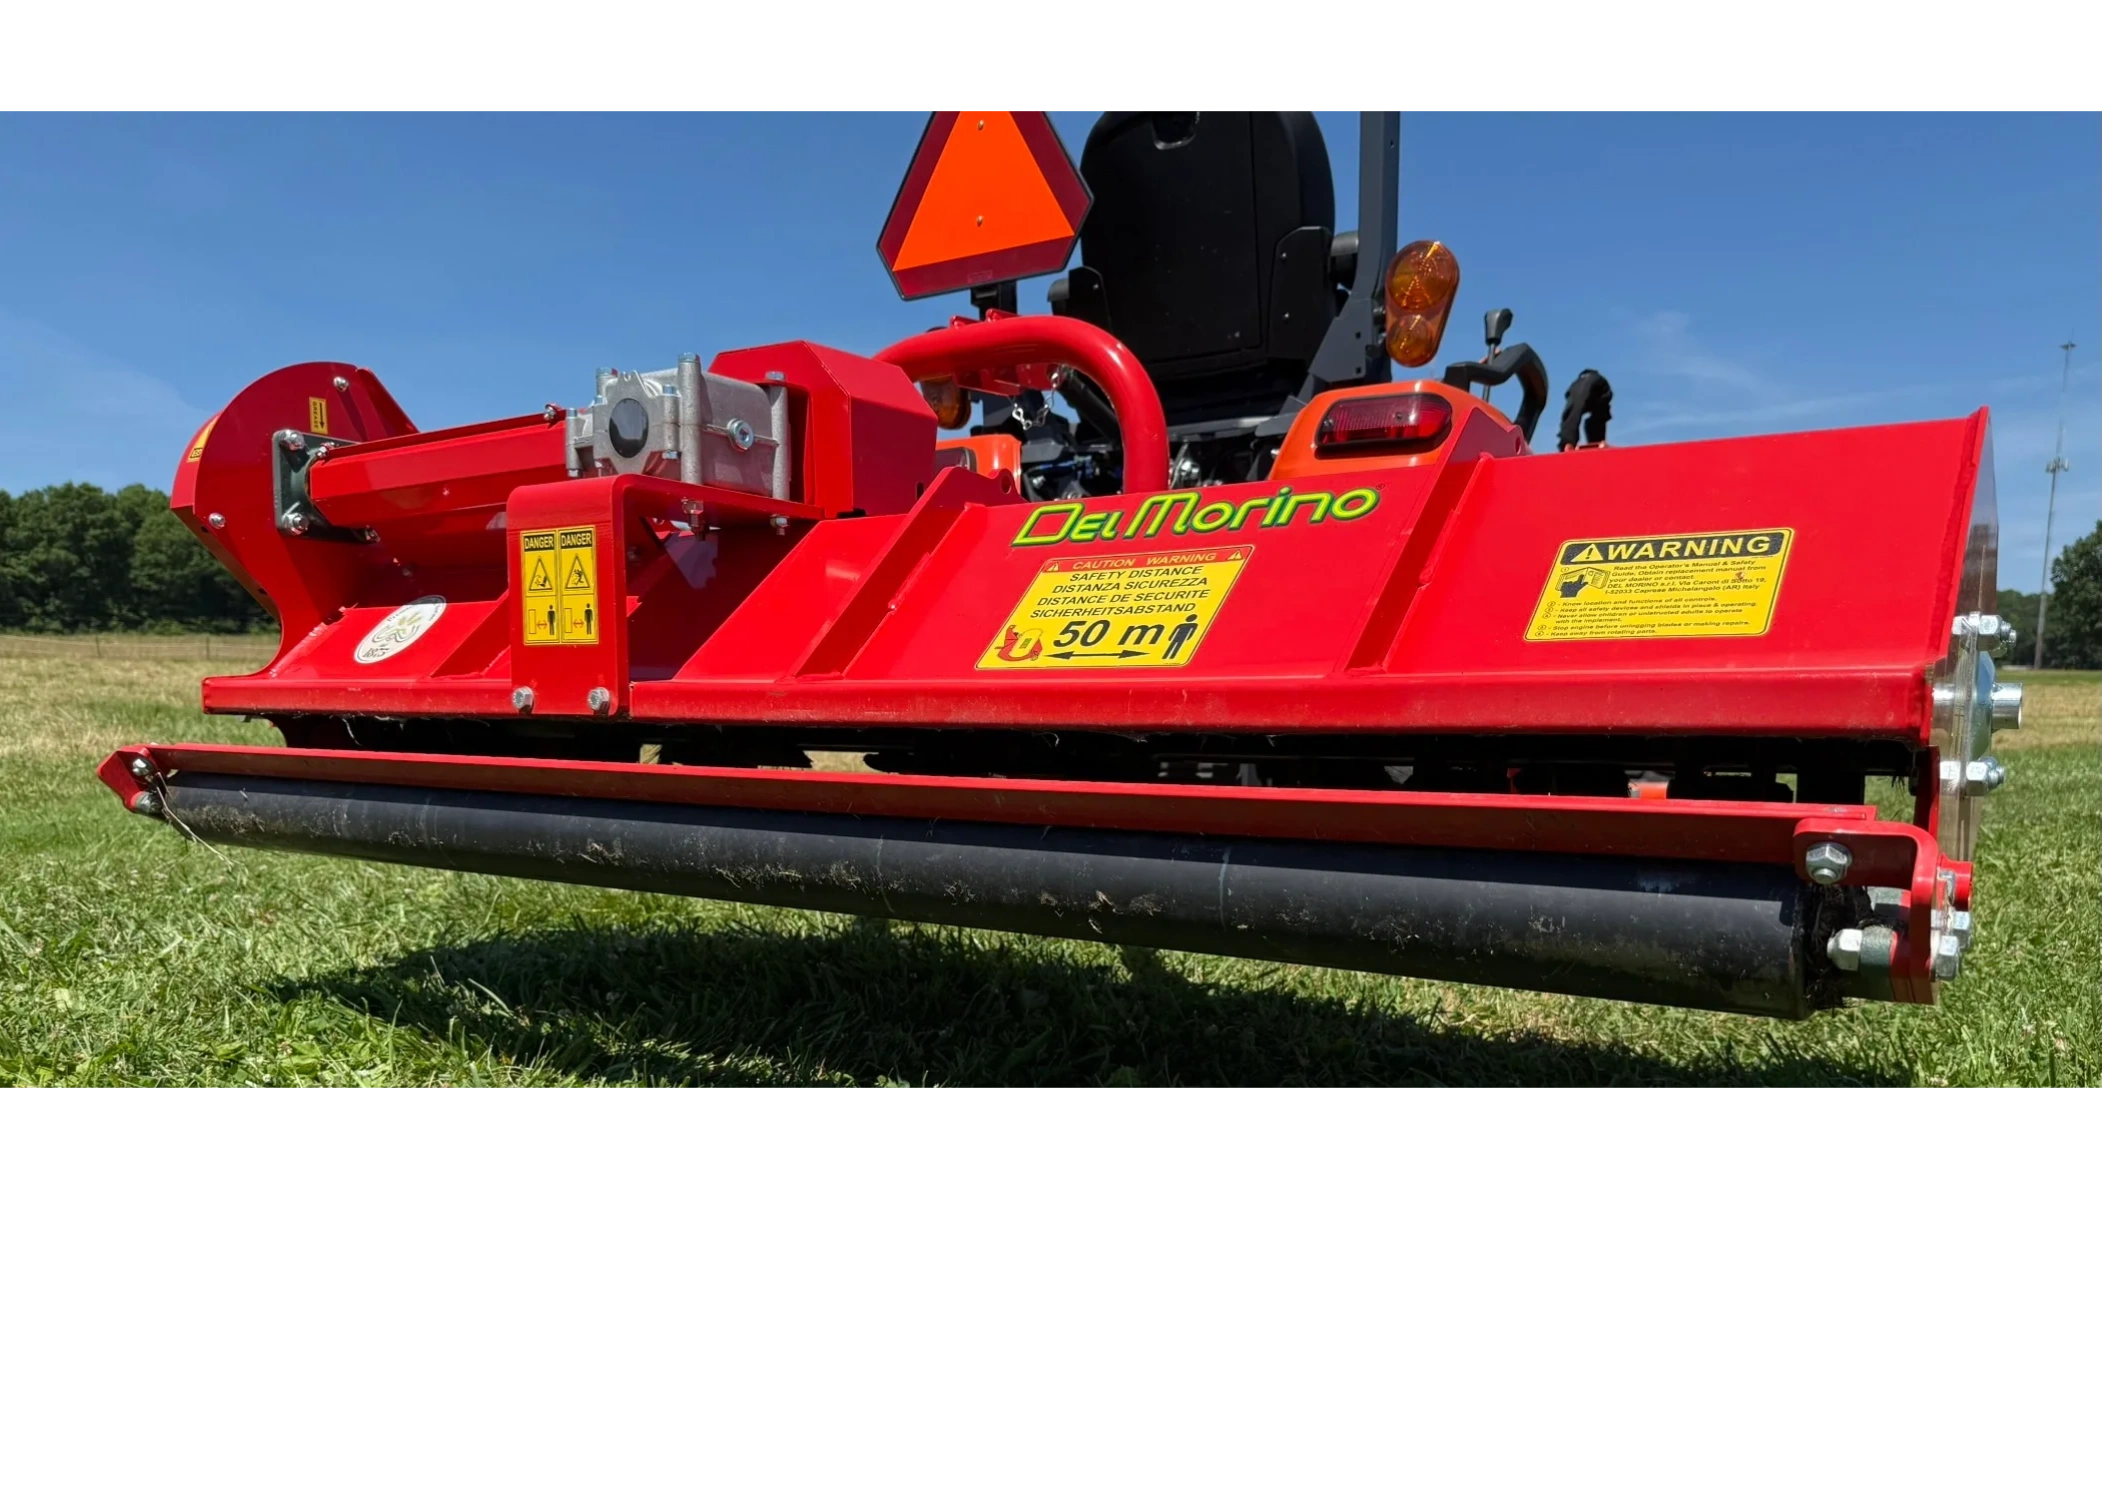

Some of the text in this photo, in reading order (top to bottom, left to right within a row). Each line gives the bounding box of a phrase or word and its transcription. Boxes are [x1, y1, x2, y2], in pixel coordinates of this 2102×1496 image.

[524, 535, 554, 549] DANGER
[561, 533, 592, 547] DANGER
[1607, 536, 1771, 560] WARNING
[1072, 552, 1217, 570] CAUTION WARNING
[1069, 565, 1204, 582] SAFETY DISTANCE
[1052, 577, 1208, 594] DISTANZA SICUREZZA
[1037, 589, 1211, 606] DISTANCE DE SECURITE
[1030, 603, 1196, 618] SICHERHEITSABSTAND
[1053, 620, 1165, 647] 50 m
